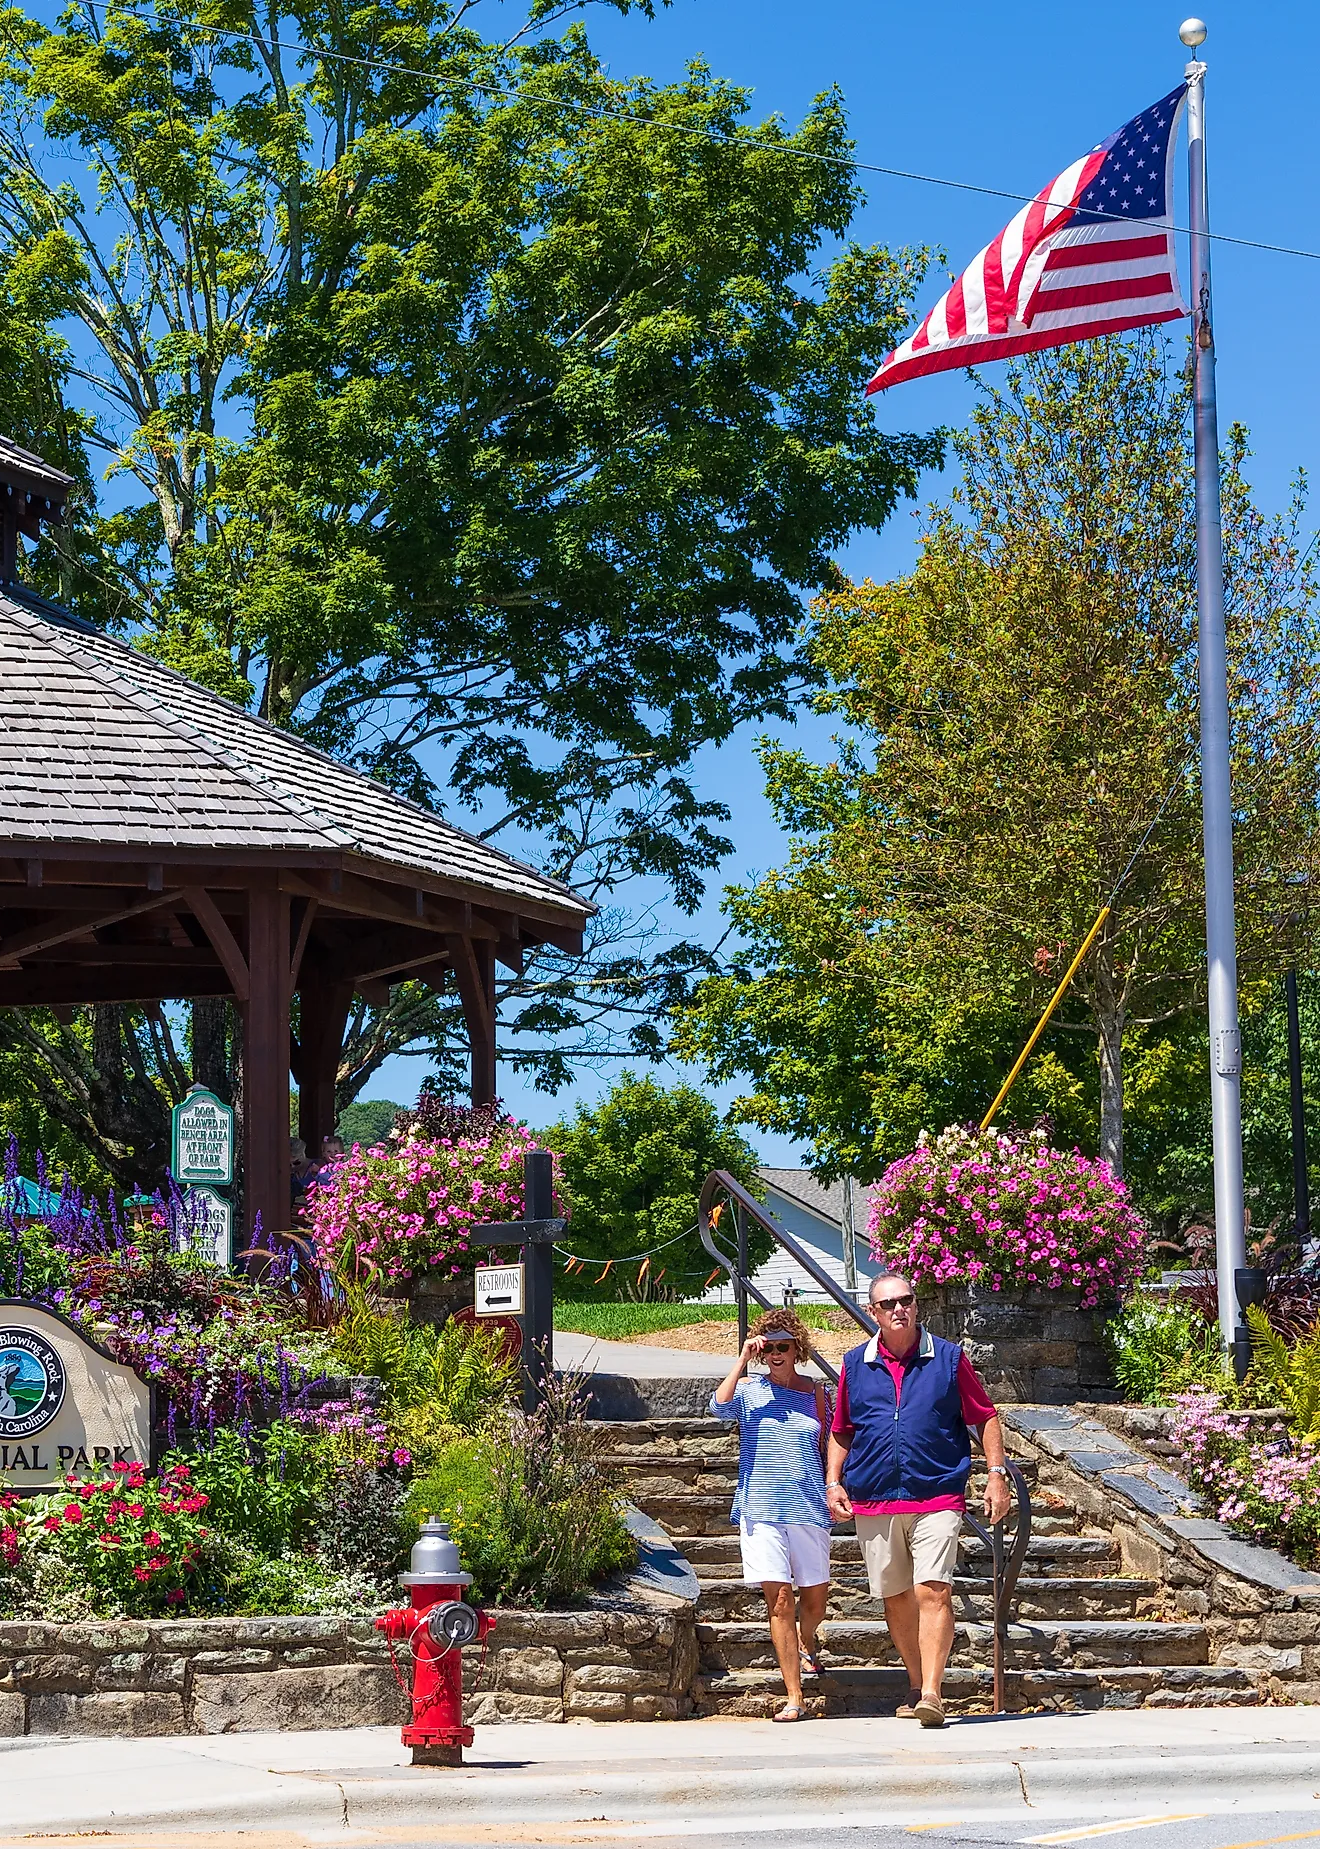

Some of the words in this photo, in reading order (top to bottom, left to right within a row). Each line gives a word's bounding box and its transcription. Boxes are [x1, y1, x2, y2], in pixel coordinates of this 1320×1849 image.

[194, 1106, 216, 1116] DOGS
[181, 1118, 218, 1128] ALLOWED
[219, 1119, 228, 1129] IN
[180, 1130, 207, 1141] BENCH
[207, 1131, 228, 1141] AREA
[186, 1142, 197, 1151] AT
[197, 1142, 223, 1152] FRONT
[188, 1154, 199, 1163] OF
[199, 1154, 221, 1164] PARK
[181, 1222, 224, 1234] YOND
[191, 1236, 216, 1248] IS
[190, 1250, 219, 1262] OINT
[478, 1272, 519, 1292] RESTROOMS
[42, 1351, 61, 1383] Rock
[5, 1409, 50, 1432] Carolina
[56, 1445, 133, 1471] PARK
